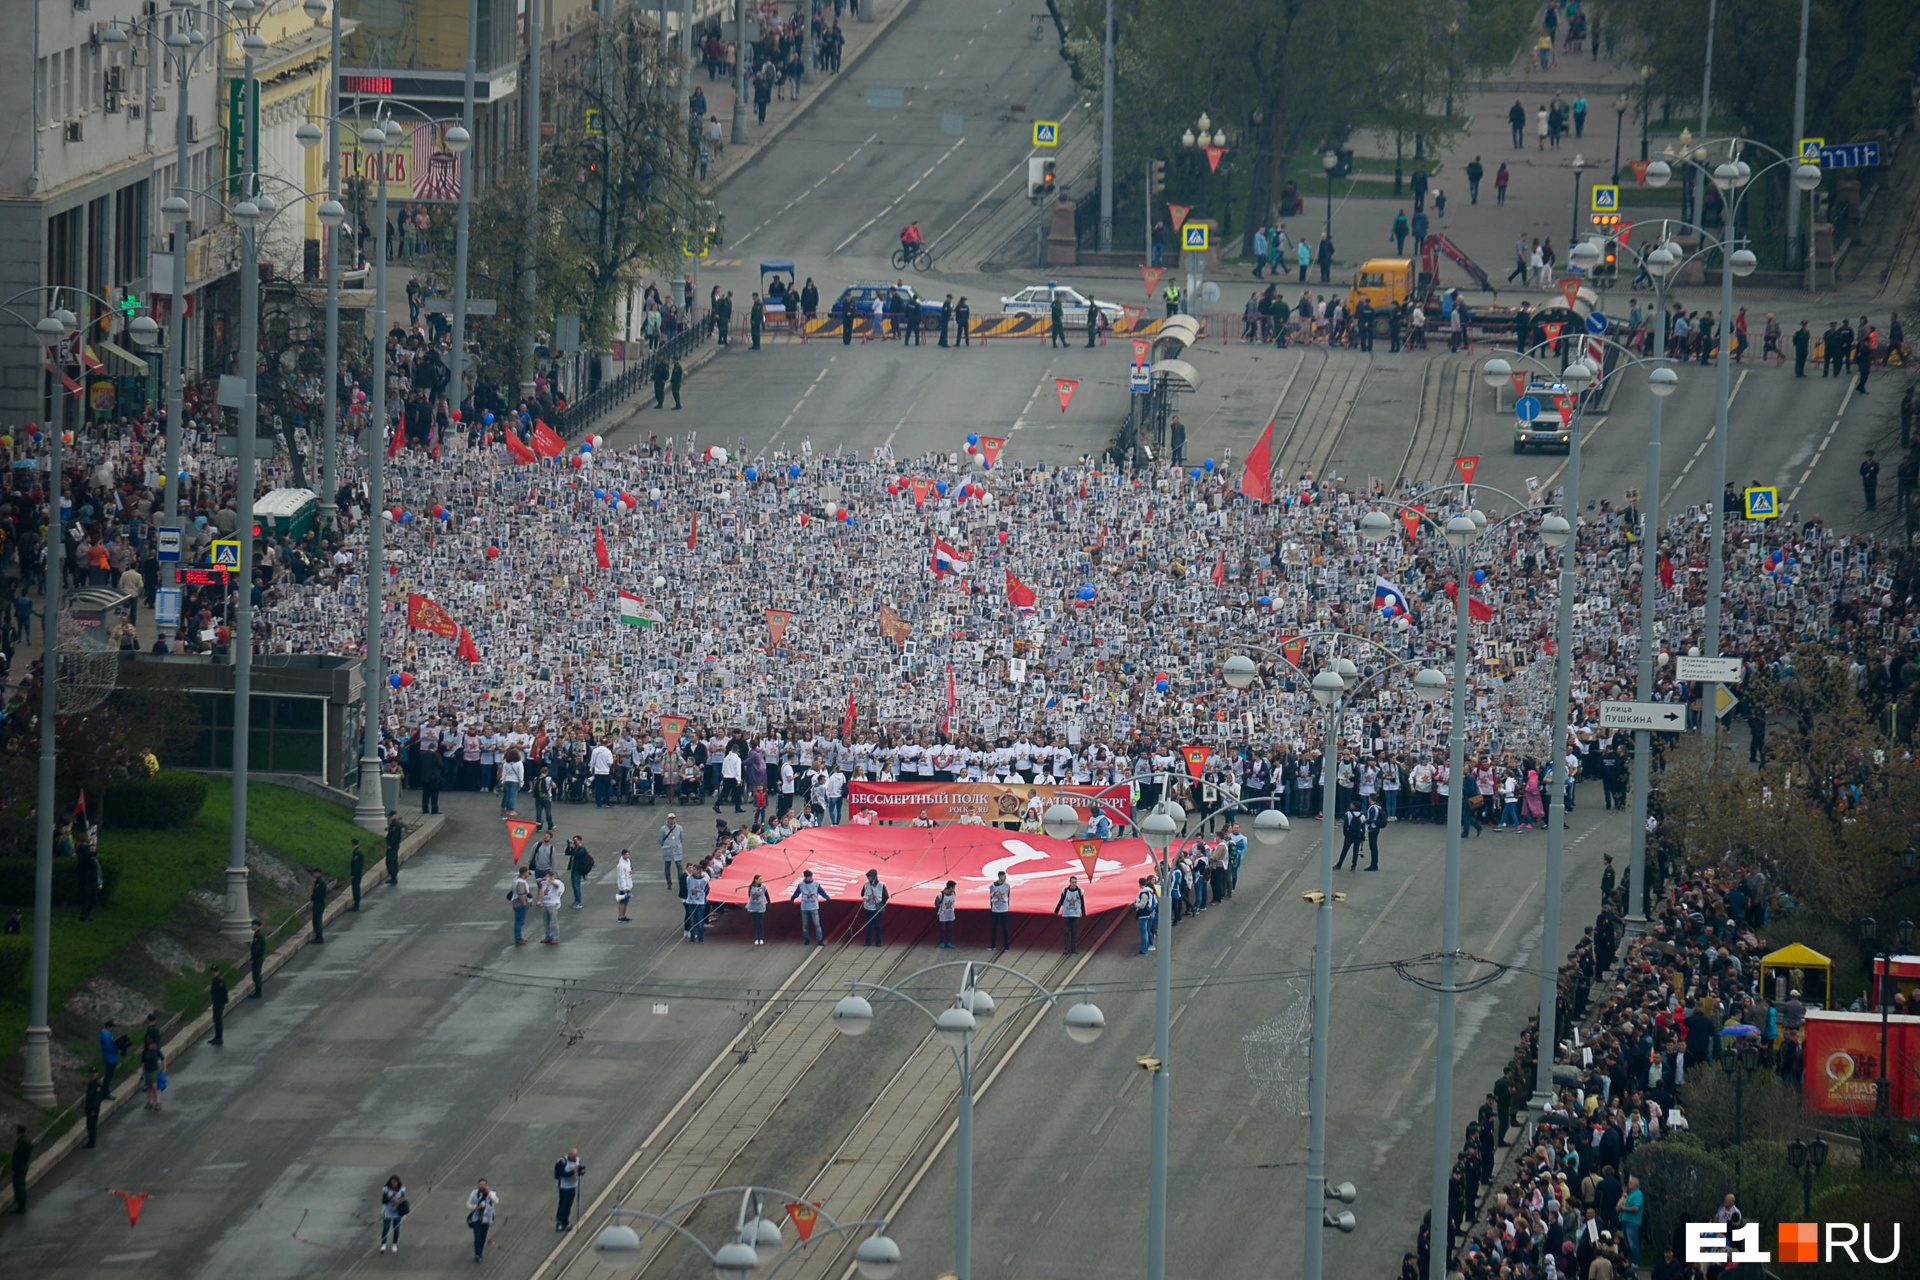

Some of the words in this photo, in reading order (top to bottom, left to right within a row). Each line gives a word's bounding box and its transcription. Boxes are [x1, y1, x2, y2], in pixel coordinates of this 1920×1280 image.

[1604, 714, 1653, 724] ПУШКИНА
[851, 792, 949, 805] БЕССМЕРТНЫЙ
[952, 793, 989, 804] ПОЛК
[1826, 1052, 1855, 1092] 9
[1846, 1082, 1878, 1095] МАЯ
